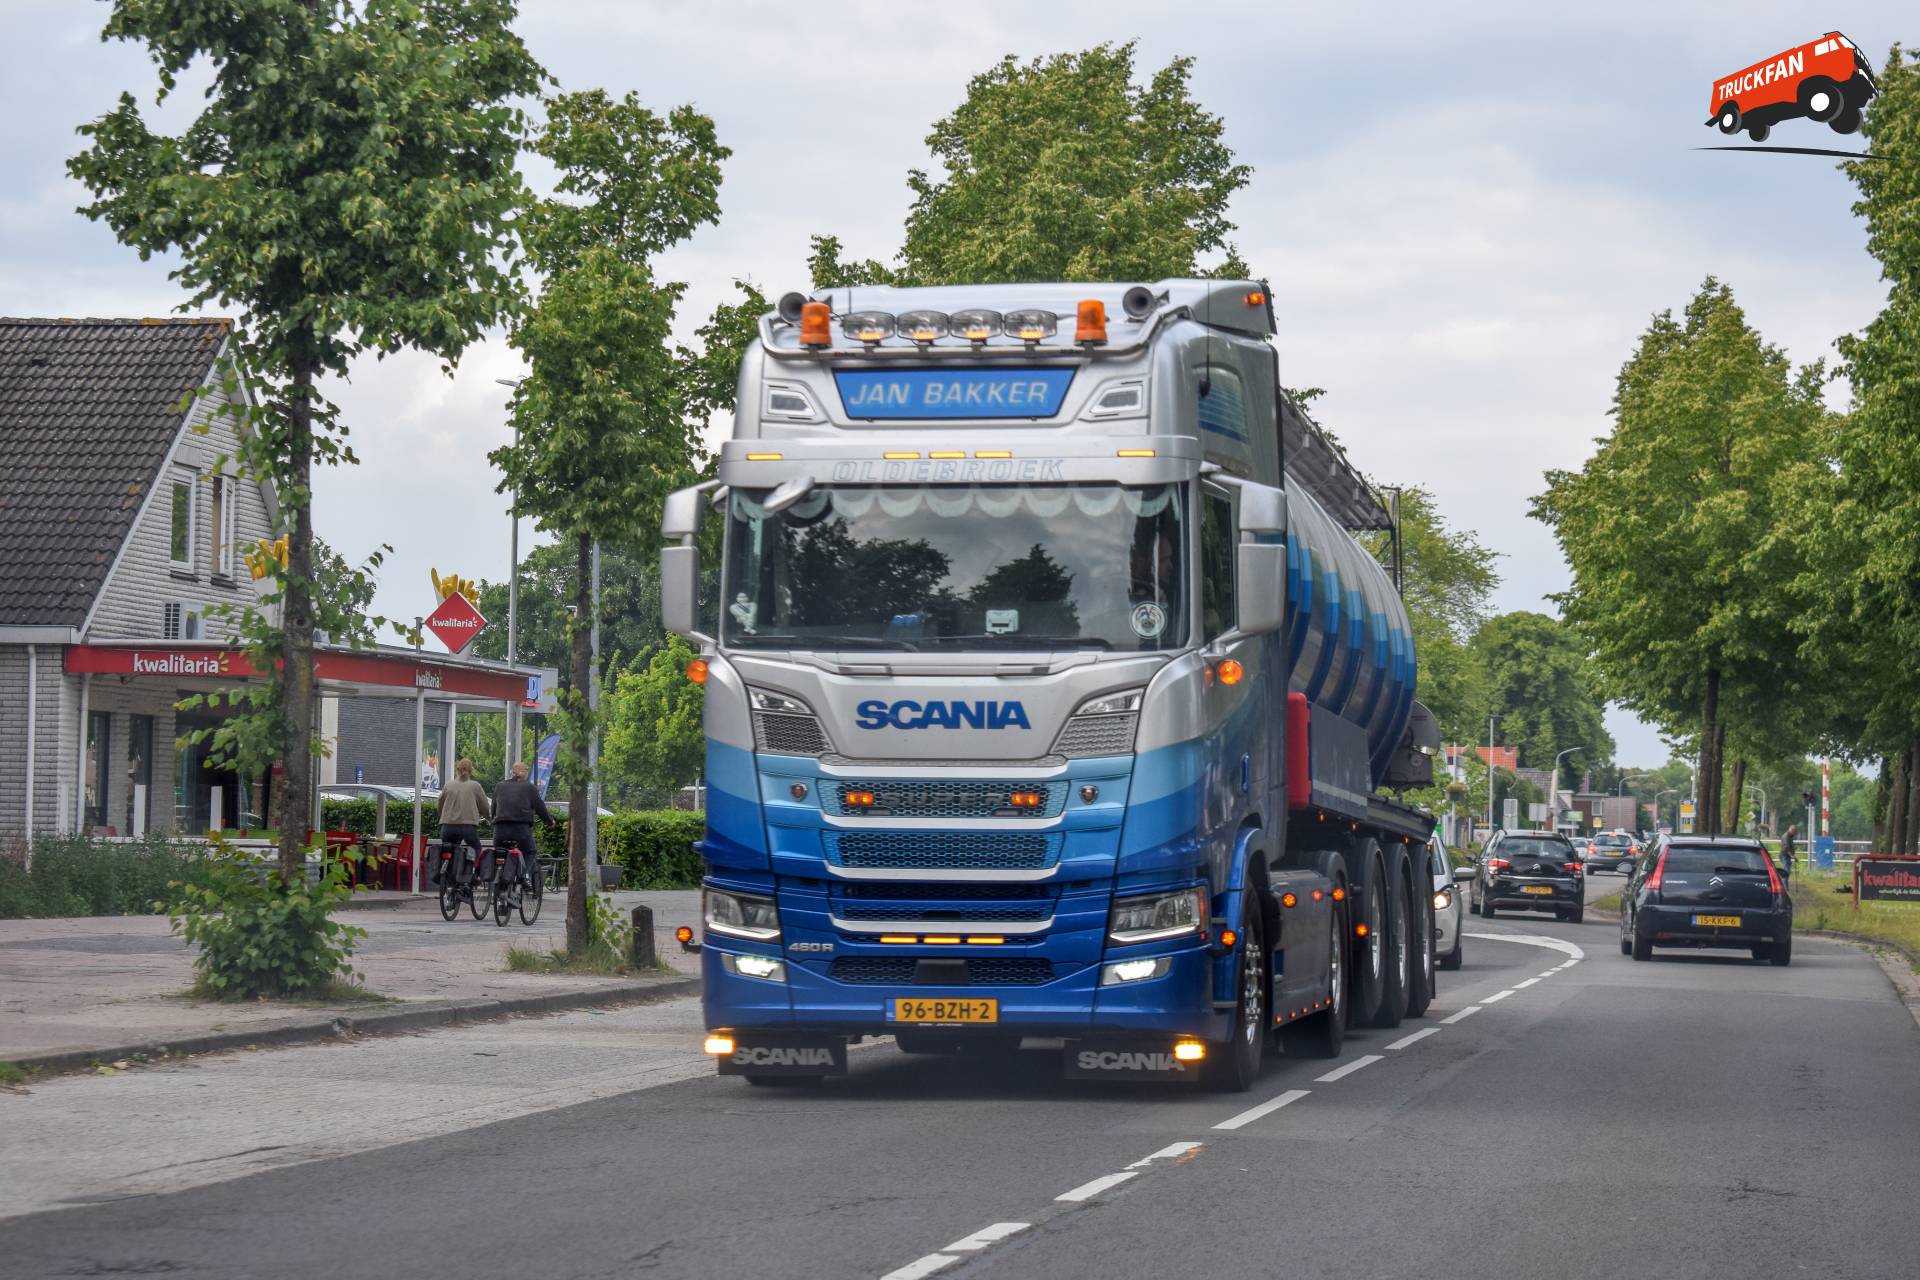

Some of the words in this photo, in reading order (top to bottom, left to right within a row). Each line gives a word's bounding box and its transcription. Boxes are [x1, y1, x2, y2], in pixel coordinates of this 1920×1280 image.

[850, 383, 911, 406] JAN
[924, 381, 1049, 405] BAKKER
[832, 459, 1065, 482] OLDEBROEK
[432, 617, 473, 628] kwalitaria
[133, 653, 219, 674] kwalitaria
[855, 700, 1032, 730] SCANIA
[902, 1002, 990, 1020] 96-BZH-2
[731, 1047, 835, 1066] SCANIA
[1077, 1051, 1185, 1071] SCANIA
